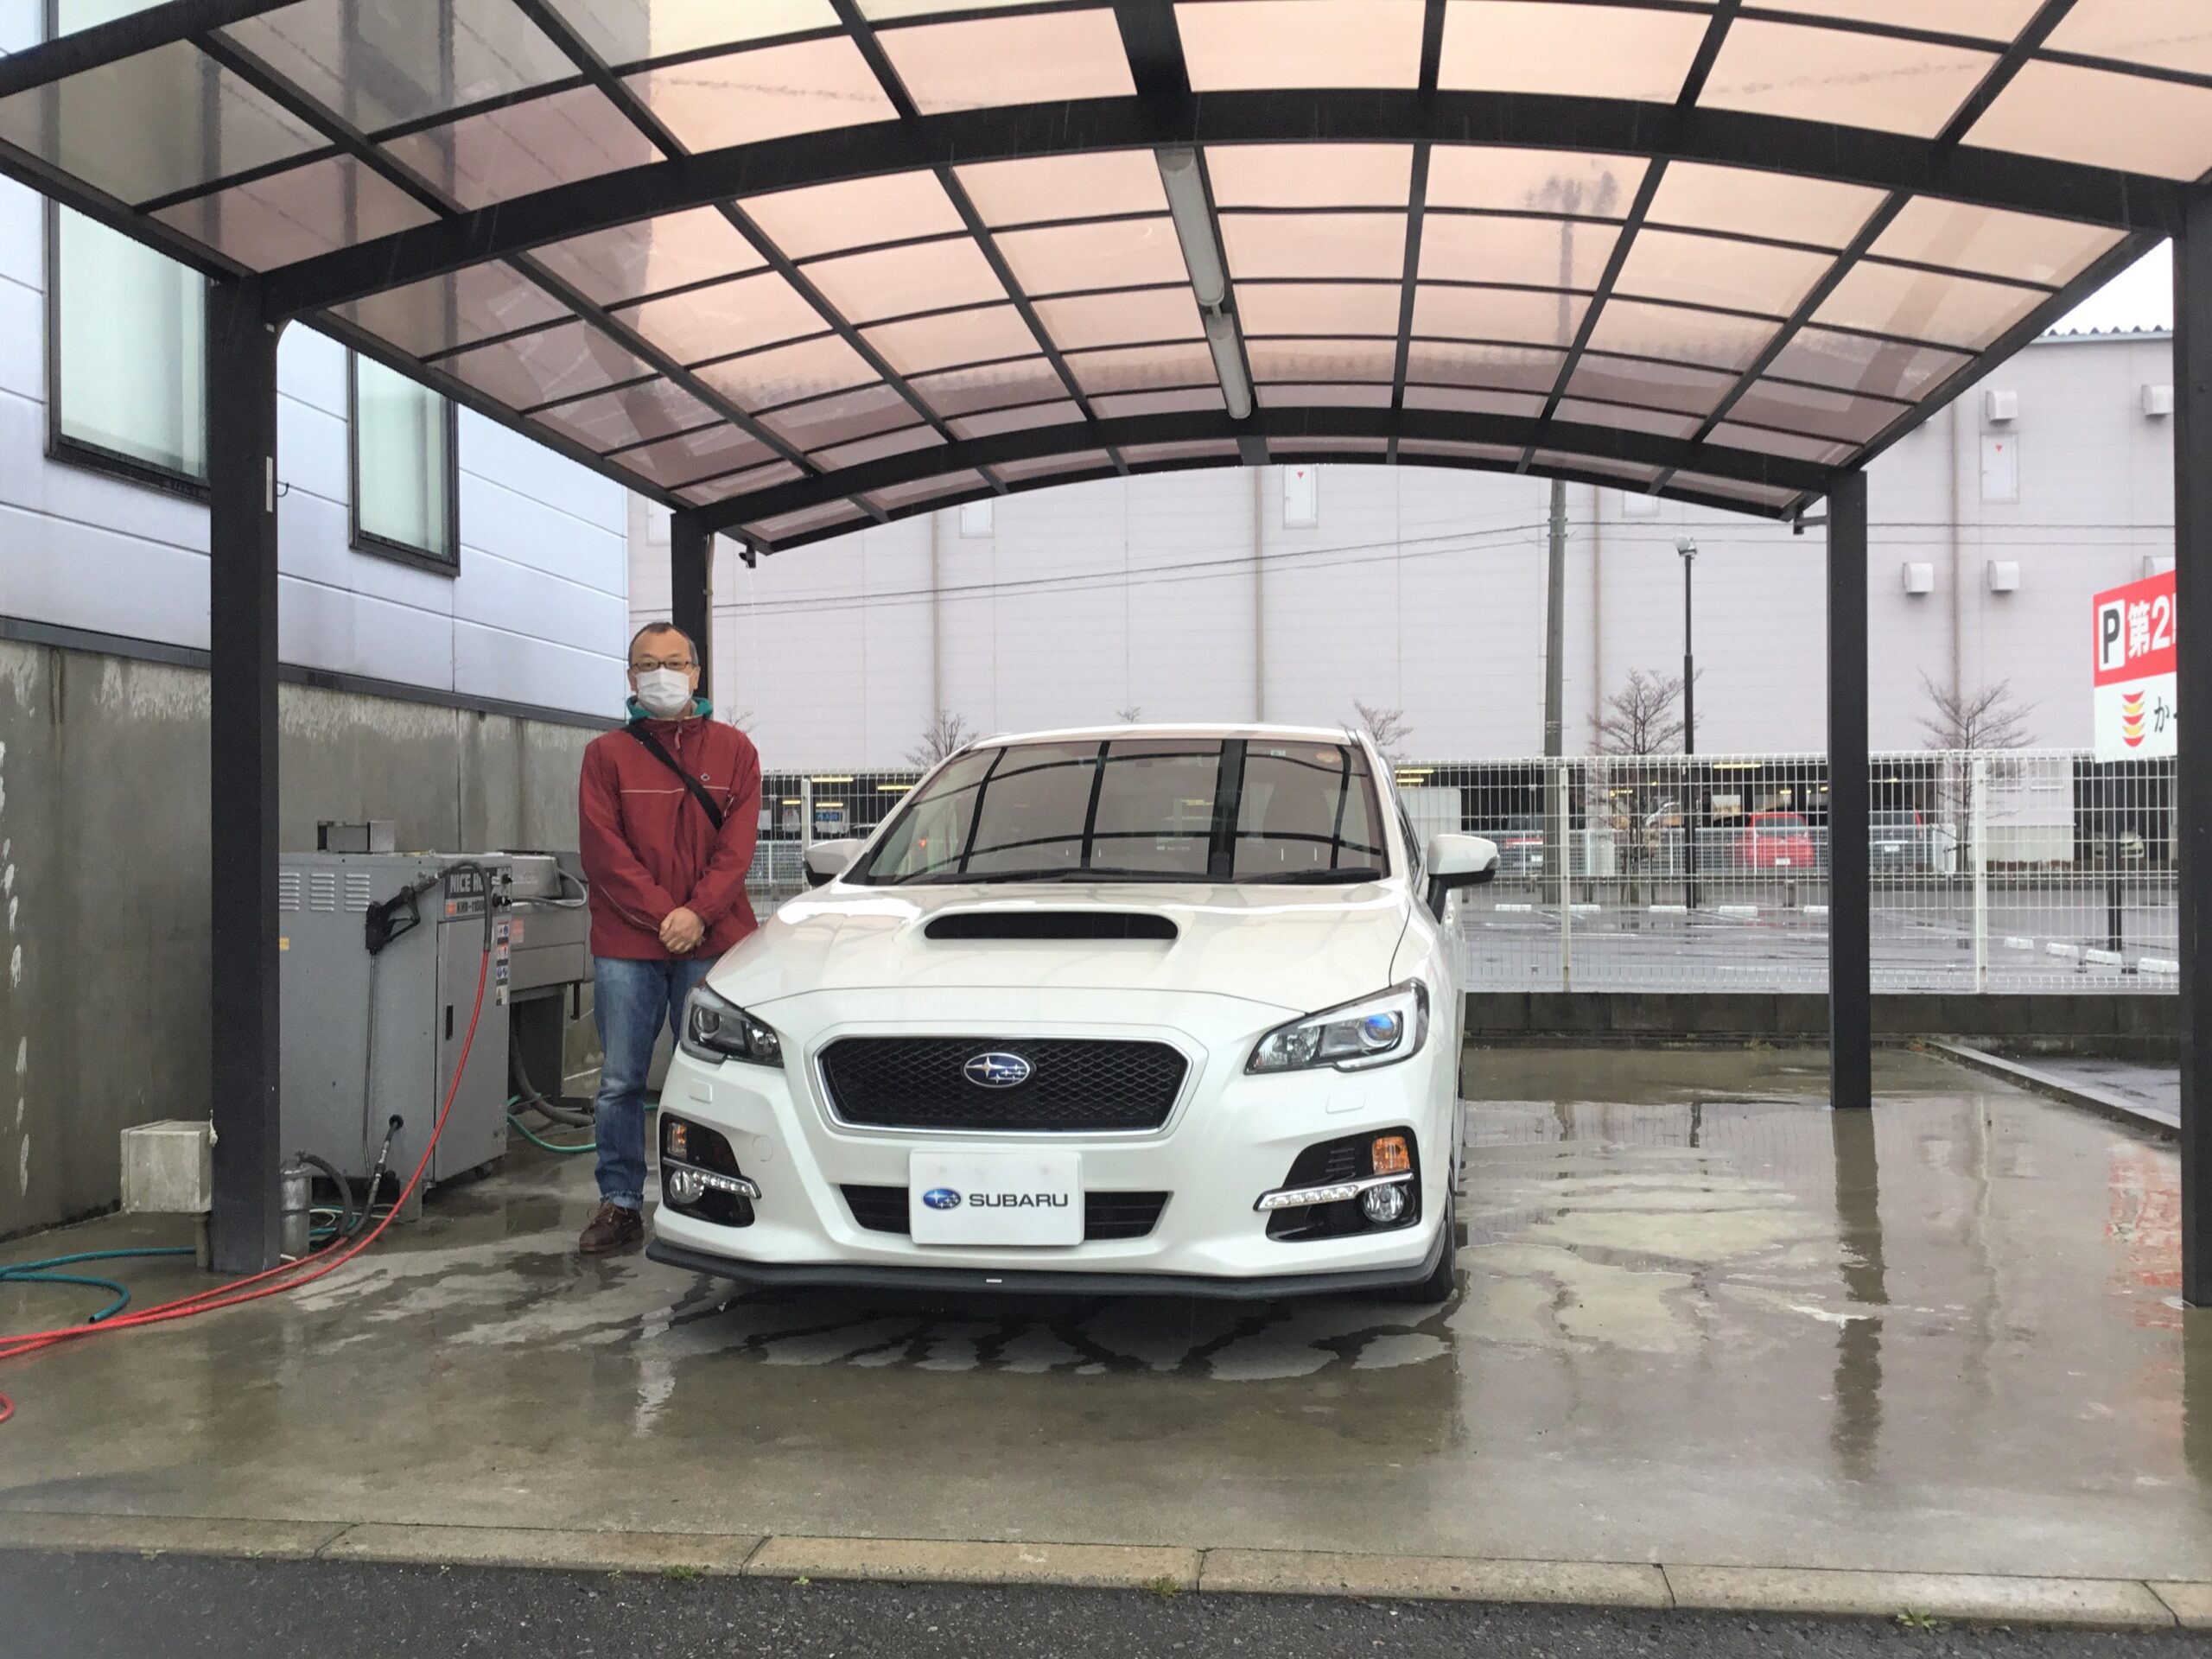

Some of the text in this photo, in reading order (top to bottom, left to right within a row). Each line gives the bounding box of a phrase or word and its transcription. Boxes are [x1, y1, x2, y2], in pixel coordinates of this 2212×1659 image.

[2103, 594, 2177, 664] P 第2
[449, 874, 471, 893] NICE
[969, 1193, 1068, 1207] SUBARU
